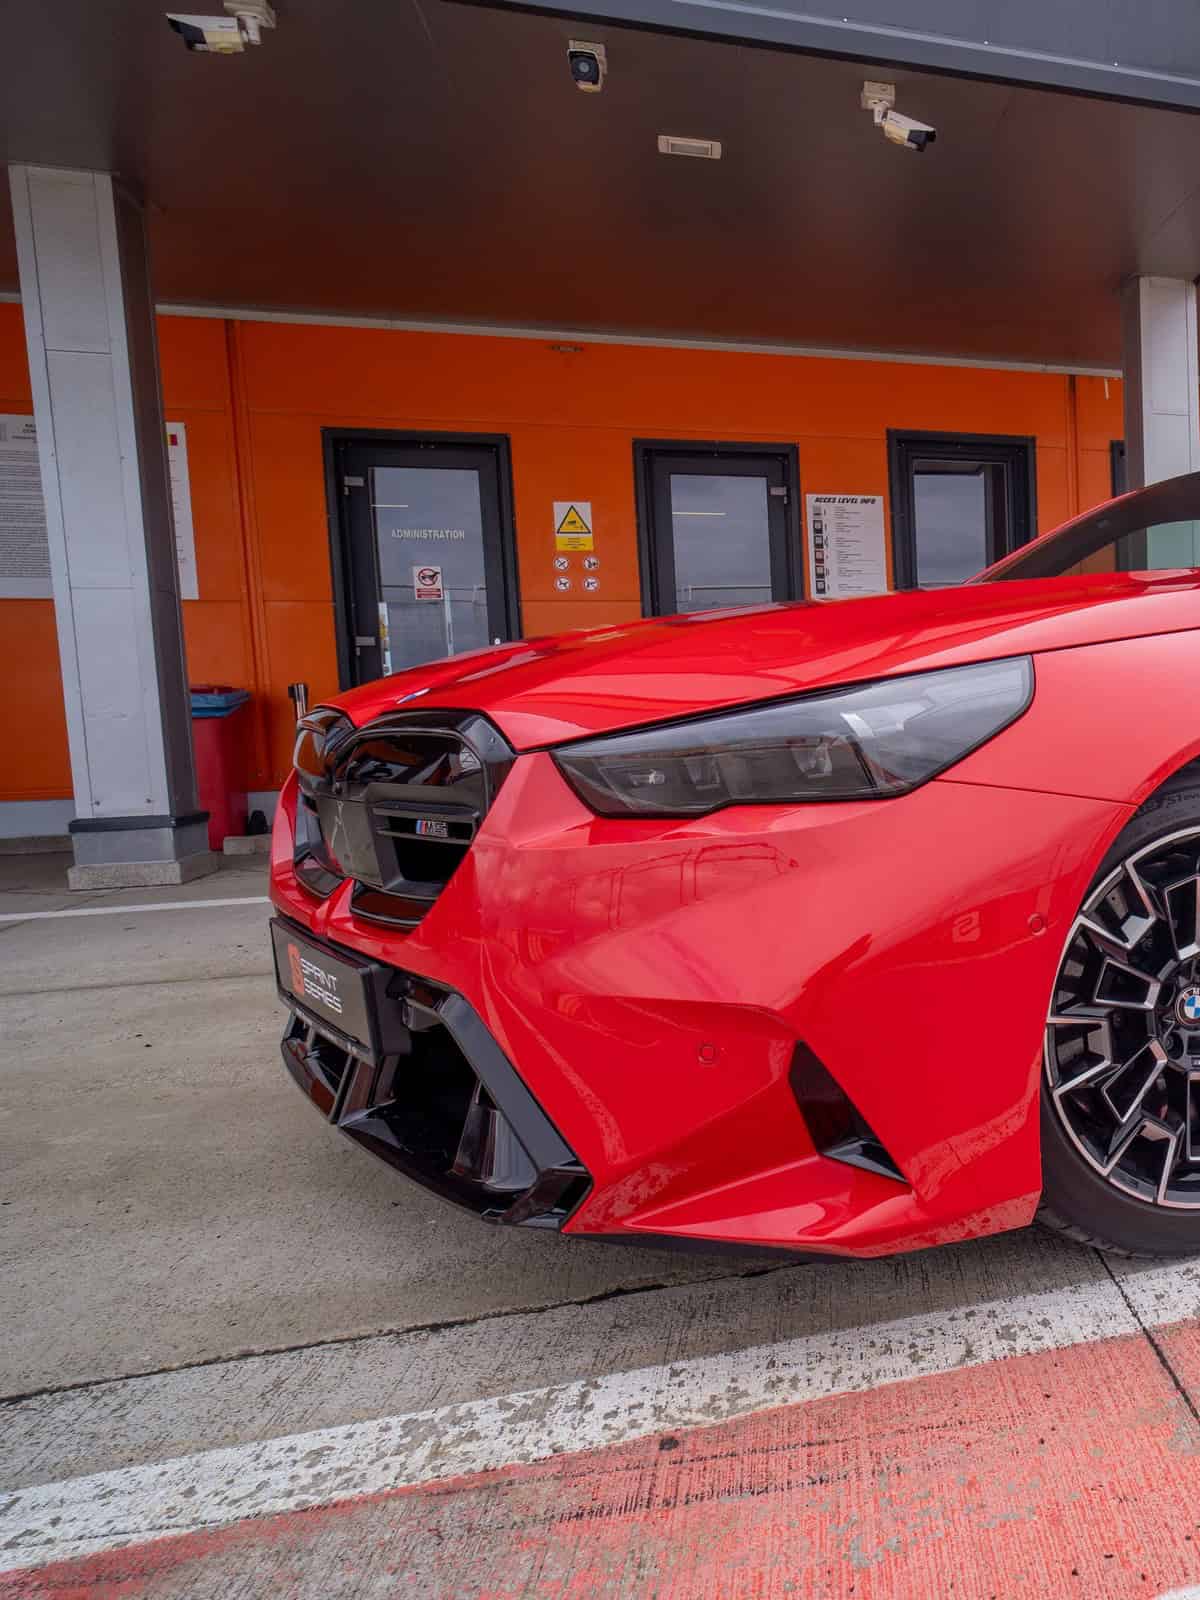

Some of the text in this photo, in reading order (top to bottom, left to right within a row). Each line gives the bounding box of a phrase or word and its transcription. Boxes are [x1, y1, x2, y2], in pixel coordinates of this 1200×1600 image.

[391, 528, 465, 539] ADMINISTRATION
[299, 957, 337, 992] SPRINT
[303, 977, 343, 1014] SERIES
